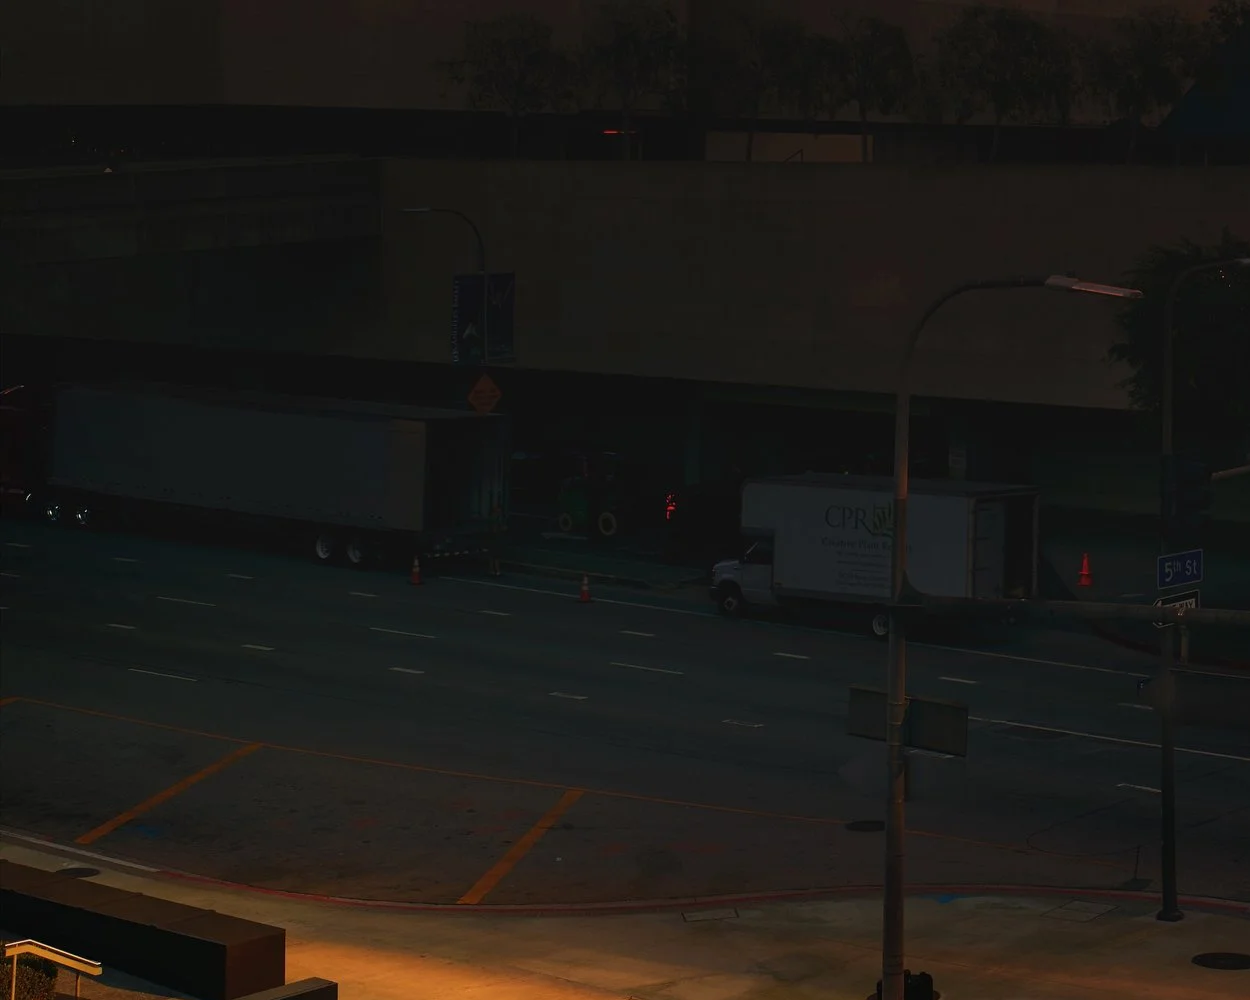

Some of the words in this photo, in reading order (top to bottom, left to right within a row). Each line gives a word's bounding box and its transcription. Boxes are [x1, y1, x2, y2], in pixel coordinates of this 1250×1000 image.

[825, 504, 873, 535] CPR
[1164, 560, 1181, 583] 5th
[1185, 559, 1197, 576] St
